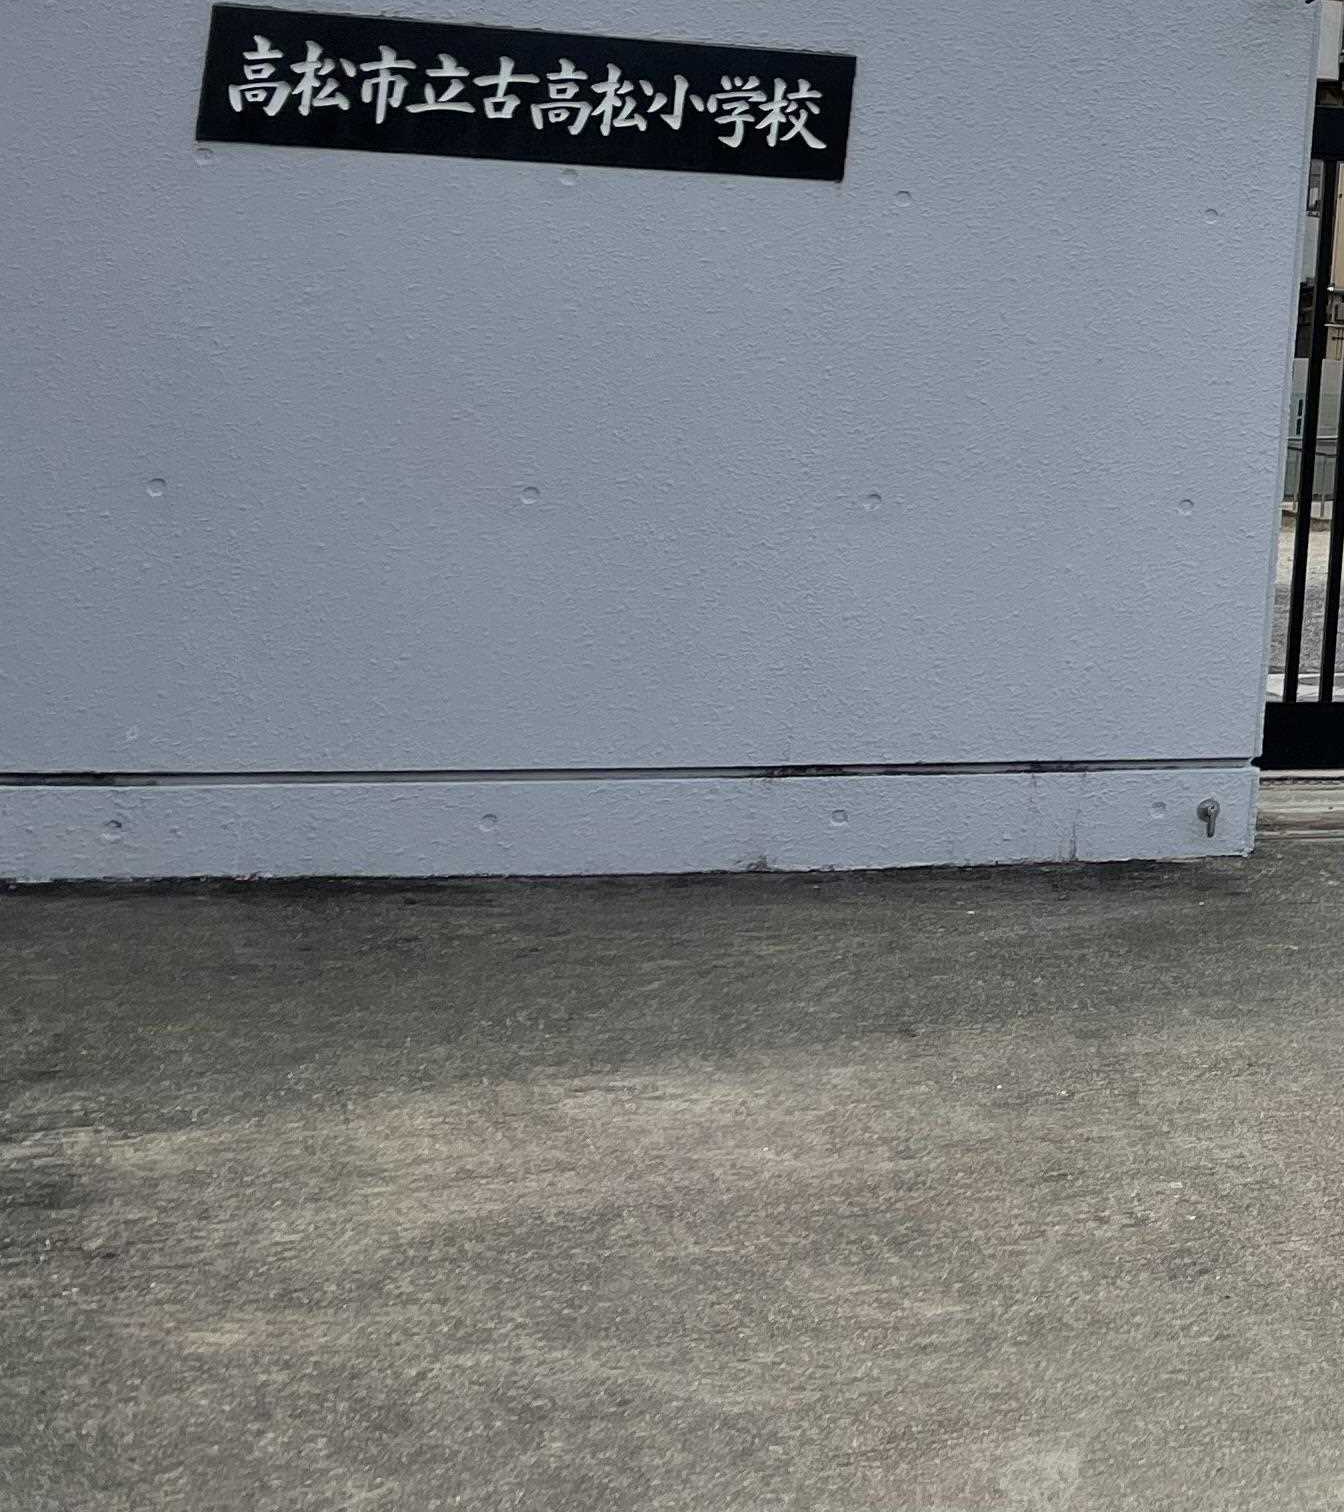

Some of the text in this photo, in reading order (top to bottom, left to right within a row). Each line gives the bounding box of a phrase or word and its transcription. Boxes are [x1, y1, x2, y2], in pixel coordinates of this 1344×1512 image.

[227, 34, 827, 150] 高松市立古高松小学校
